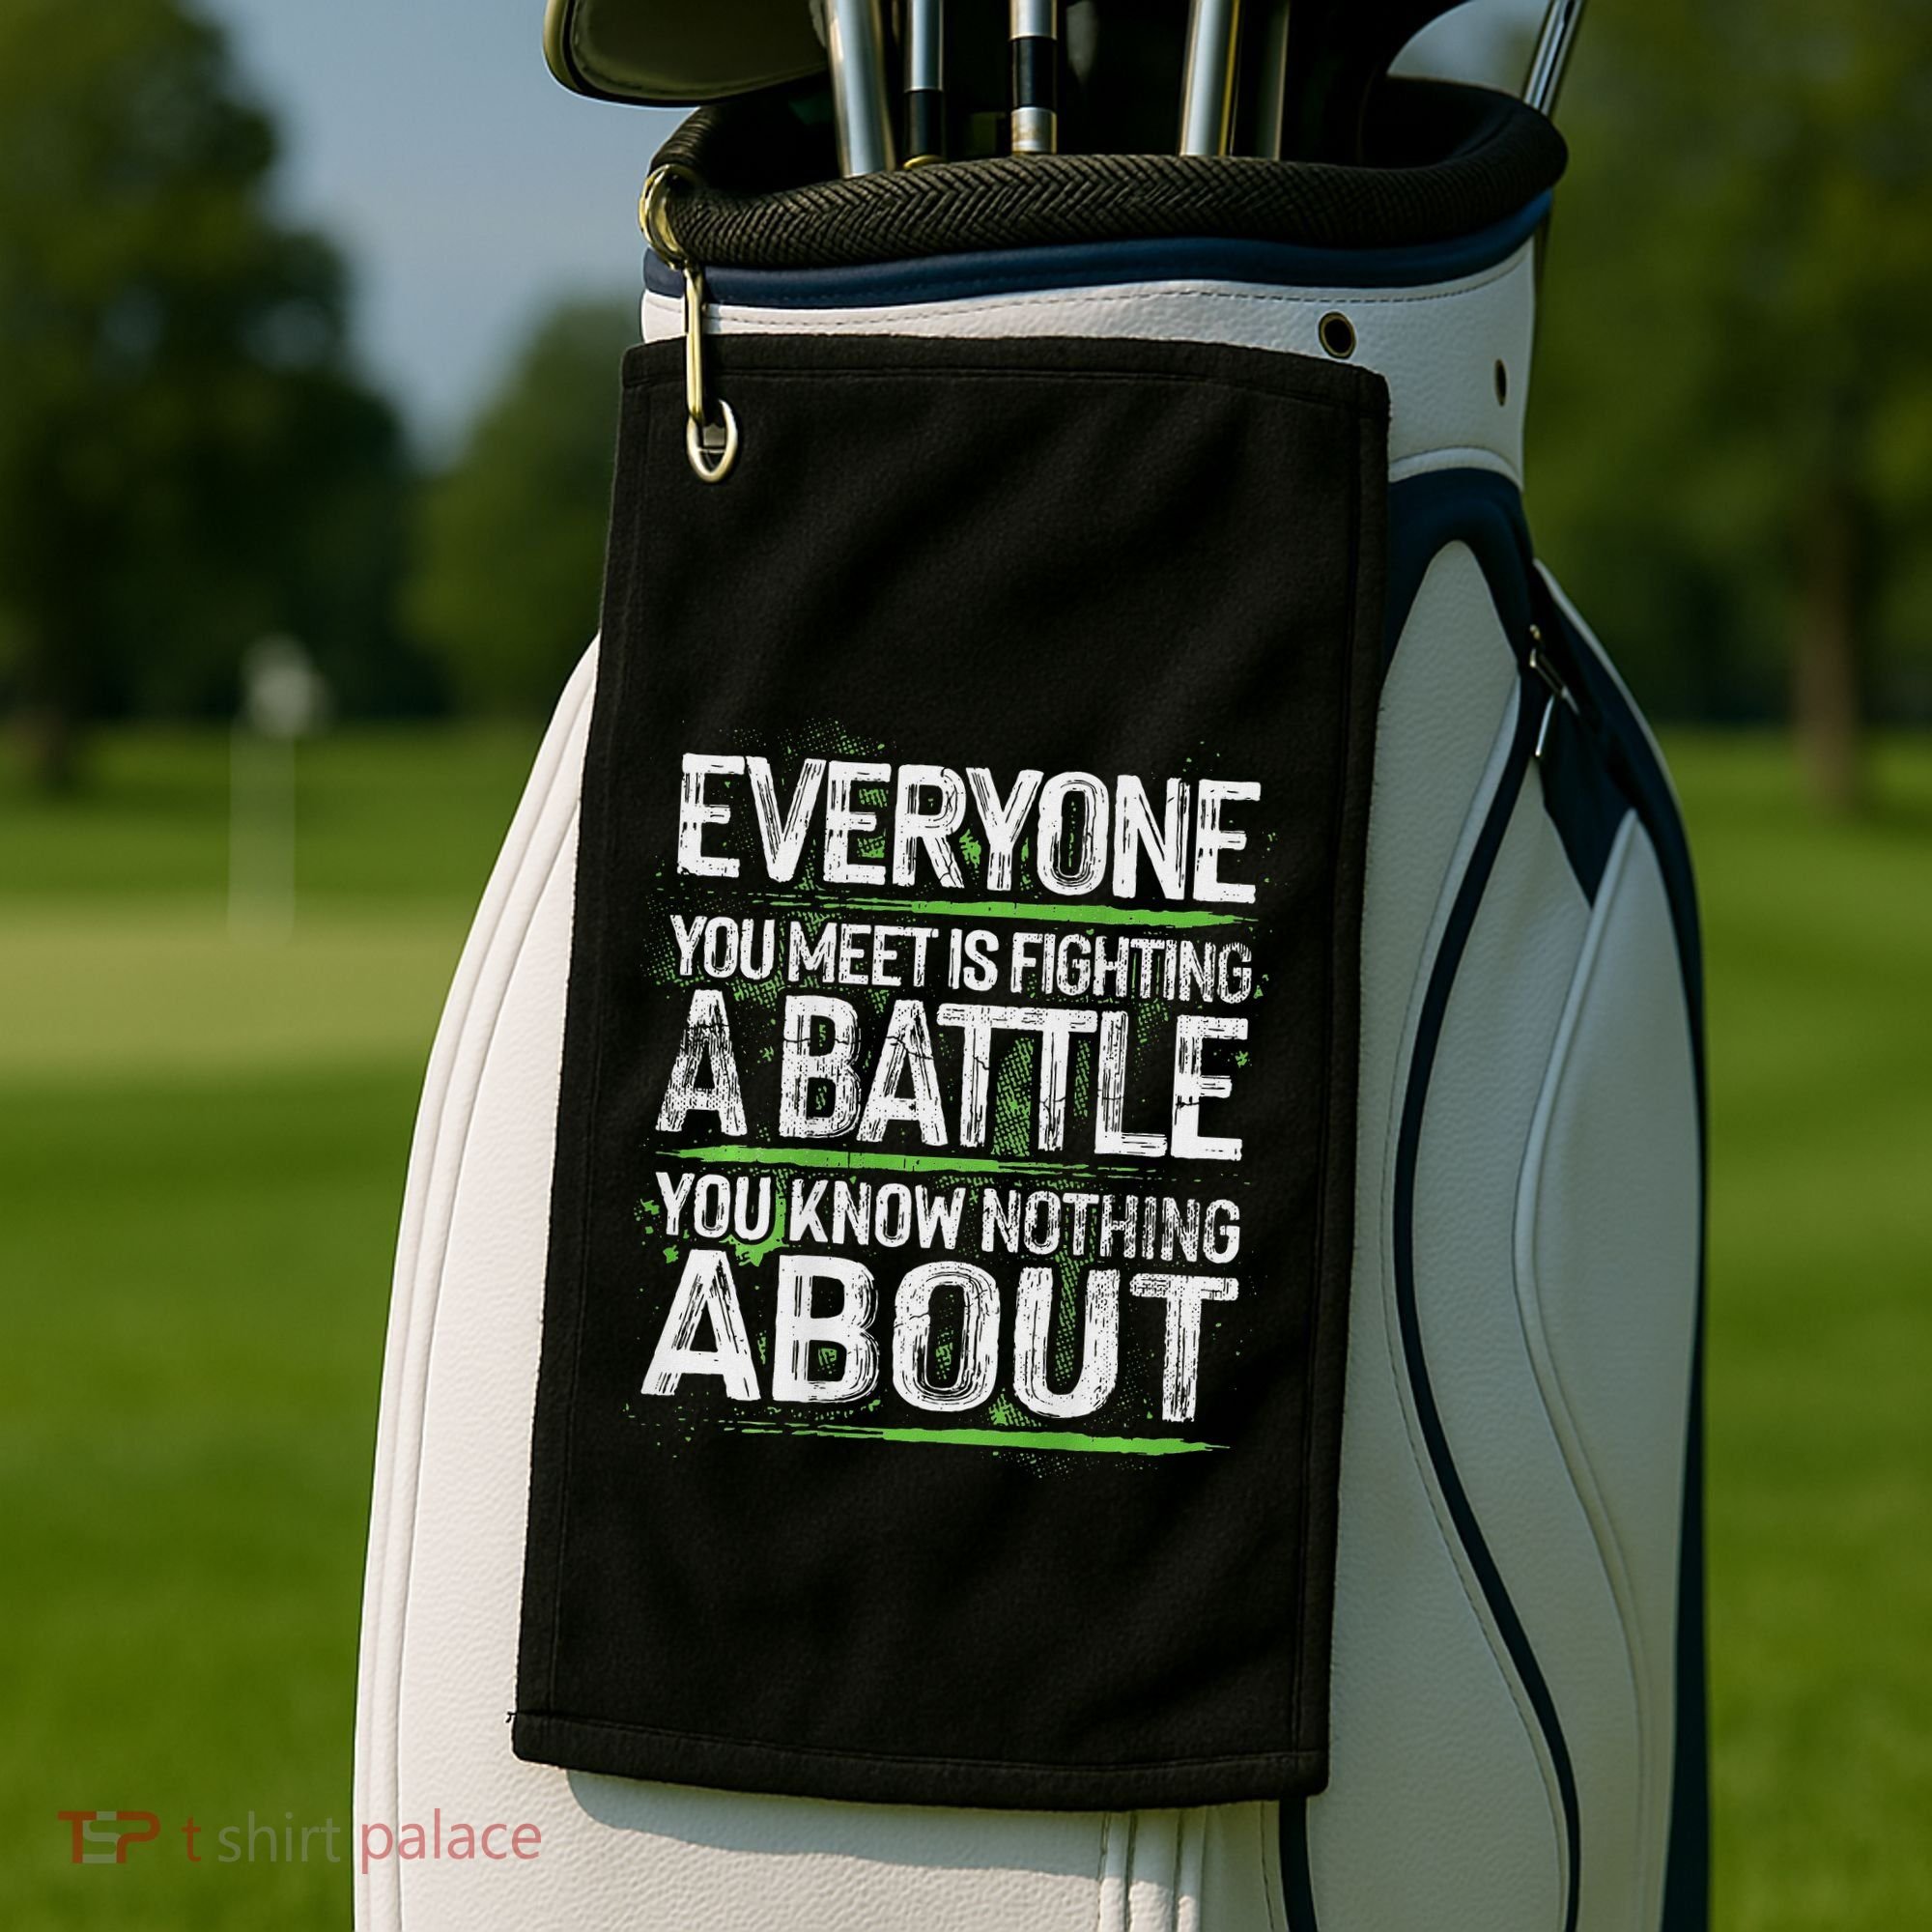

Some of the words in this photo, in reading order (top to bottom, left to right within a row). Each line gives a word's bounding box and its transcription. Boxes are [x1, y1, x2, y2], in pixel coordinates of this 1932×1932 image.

[676, 753, 1262, 904] EVERYONE
[669, 914, 775, 980] YOU
[787, 921, 939, 988] MEET
[948, 927, 1000, 992] IS
[1010, 931, 1253, 1005] FIGHTING
[655, 988, 748, 1137] A
[778, 995, 1249, 1161] BATTLE
[655, 1171, 772, 1241] YOU
[789, 1178, 966, 1250] KNOW
[980, 1187, 1240, 1265] NOTHING
[640, 1248, 1239, 1423] ABOUT
